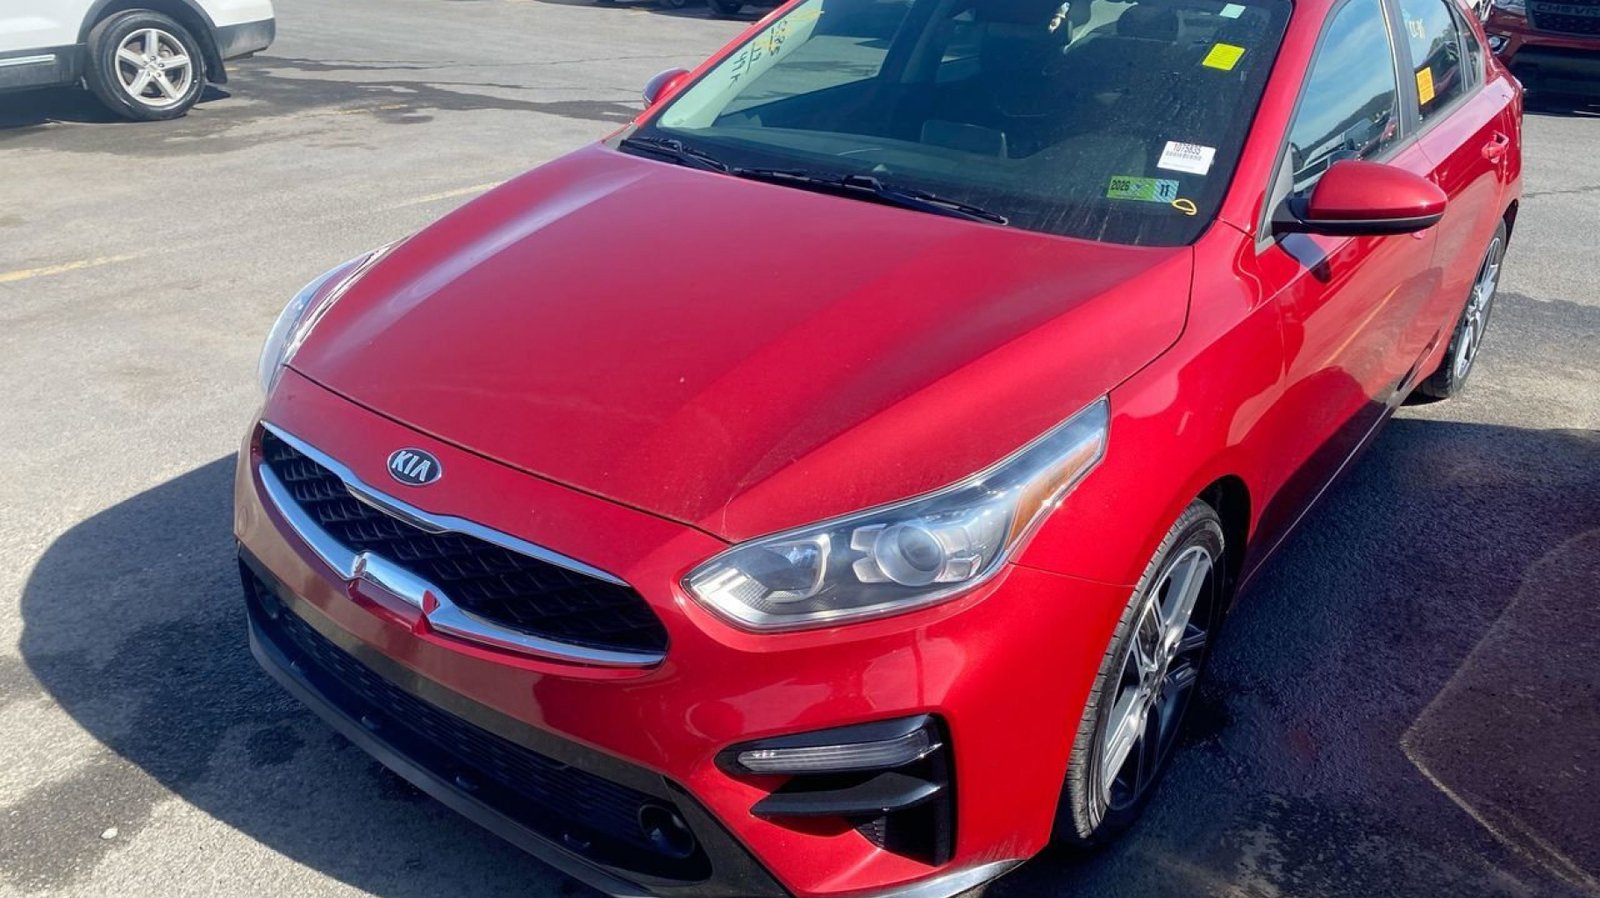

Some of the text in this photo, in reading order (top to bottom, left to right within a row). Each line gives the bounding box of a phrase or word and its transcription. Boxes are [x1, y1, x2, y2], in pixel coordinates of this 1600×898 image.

[1110, 179, 1170, 197] 2026 11
[391, 450, 431, 482] KIA
